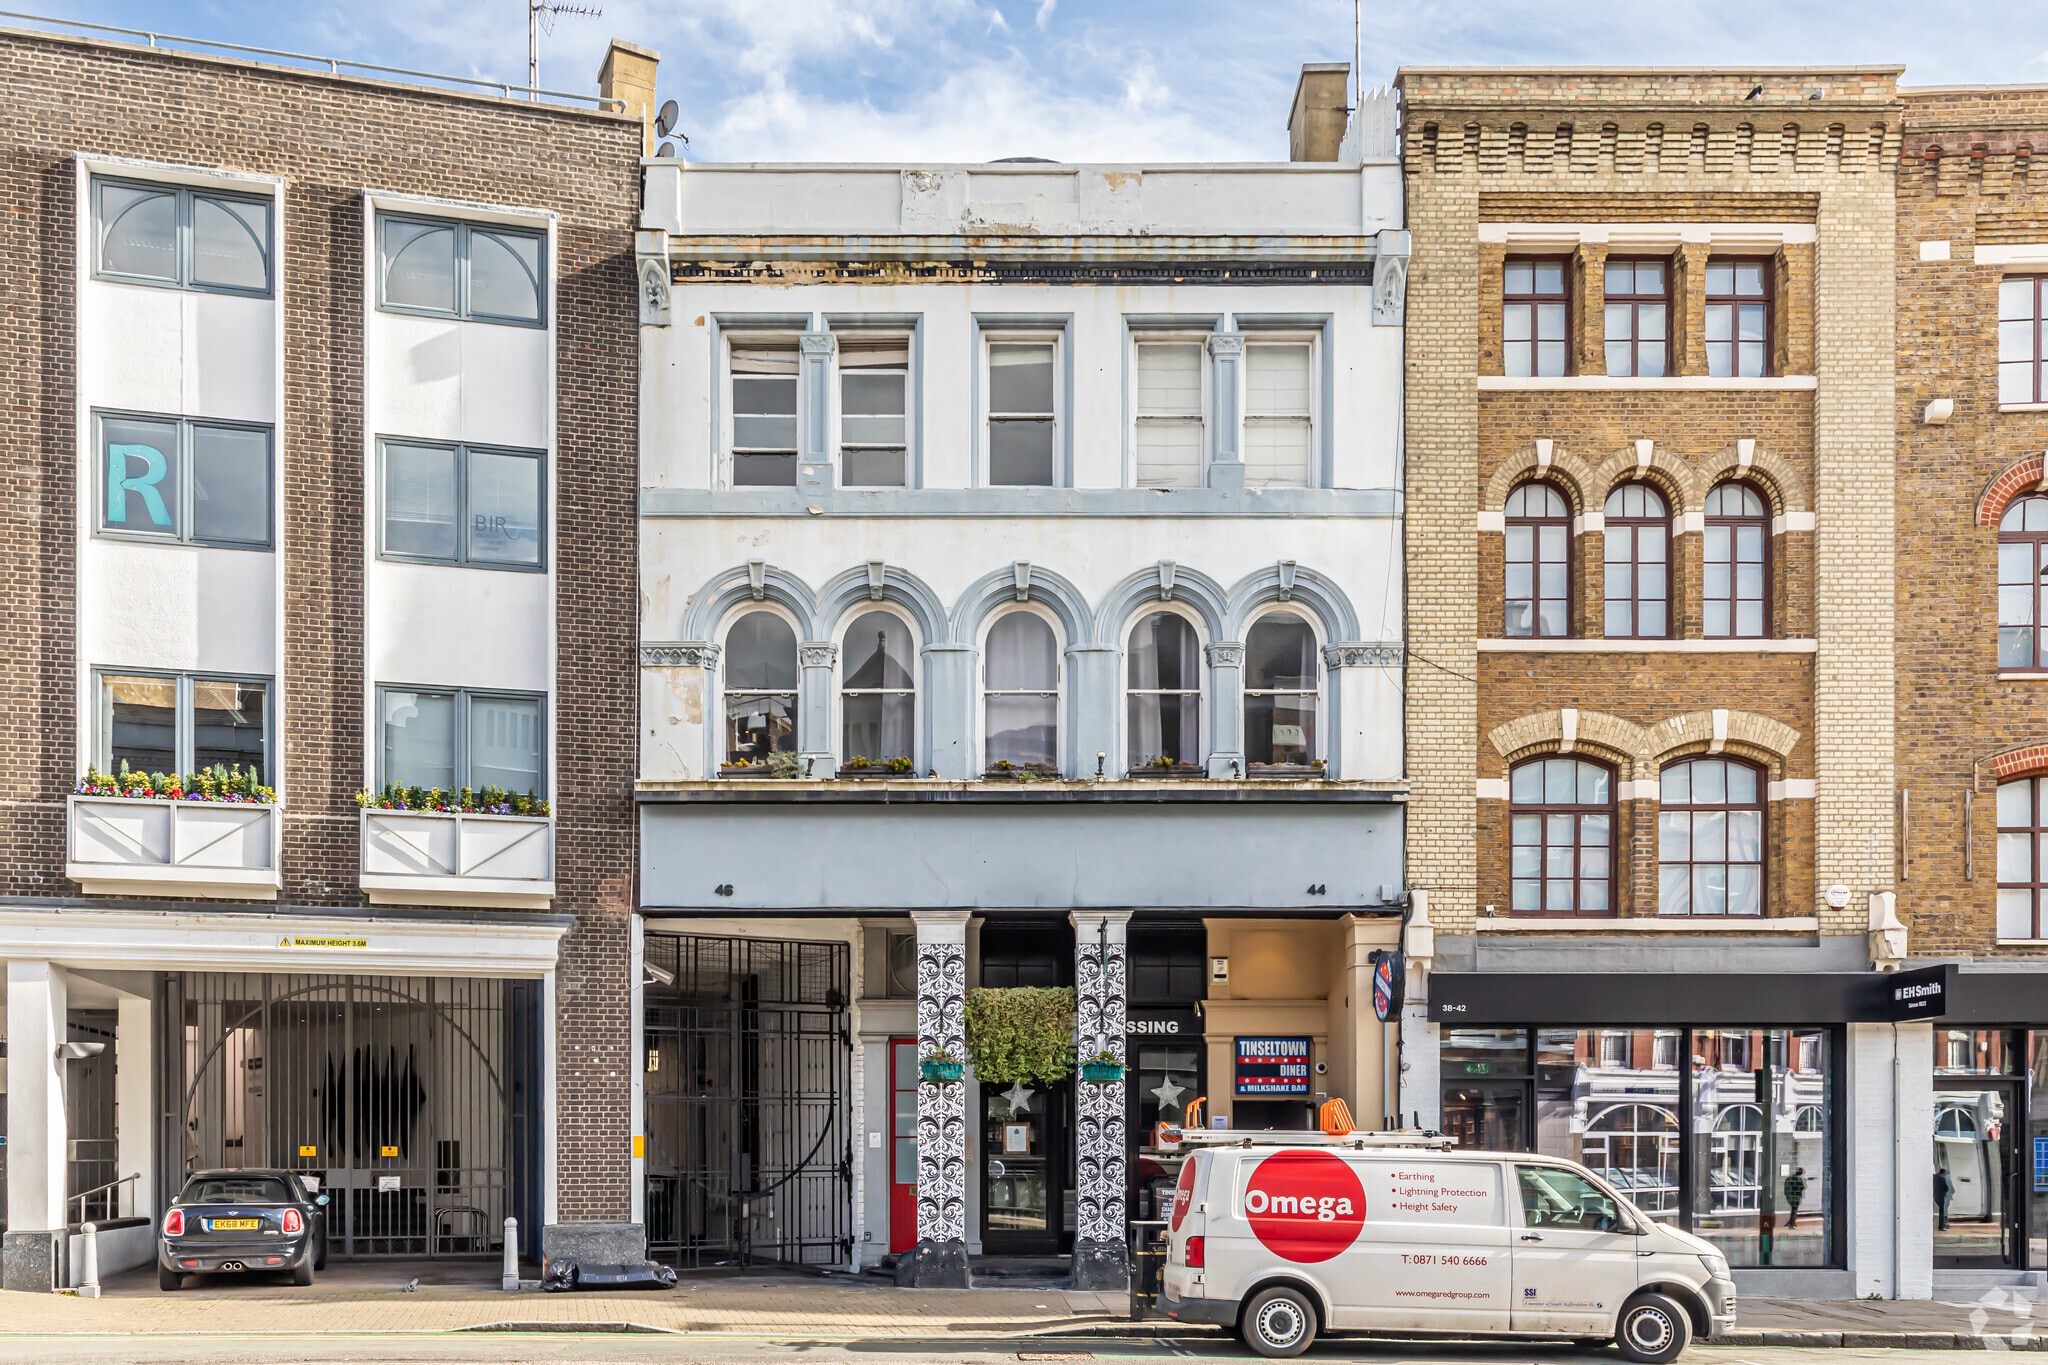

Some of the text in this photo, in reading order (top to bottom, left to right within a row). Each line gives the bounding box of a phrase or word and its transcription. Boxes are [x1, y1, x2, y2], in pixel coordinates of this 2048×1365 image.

[107, 443, 173, 526] R
[475, 514, 521, 541] BIR
[714, 883, 734, 897] 46
[1306, 883, 1327, 896] 44
[295, 938, 326, 946] MAXIMUM
[327, 939, 351, 947] HEIGHT
[1442, 1004, 1467, 1012] 38-42
[1125, 1020, 1179, 1034] SSING
[1239, 1040, 1307, 1056] TINSELTOWN
[1280, 1064, 1307, 1077] DINER
[1247, 1084, 1290, 1092] MILKSHAKE
[1291, 1084, 1307, 1092] BAR
[1398, 1171, 1435, 1183] Earthing
[1399, 1187, 1487, 1198] Lightning Protection
[1245, 1189, 1354, 1222] Omega
[1399, 1201, 1458, 1213] Height Safety
[214, 1219, 256, 1228] EK68 MFE
[1441, 1255, 1460, 1265] 540
[1462, 1256, 1488, 1266] 6666
[1395, 1290, 1490, 1300] www.omegaredgroup.com
[1524, 1288, 1536, 1297] SSI
